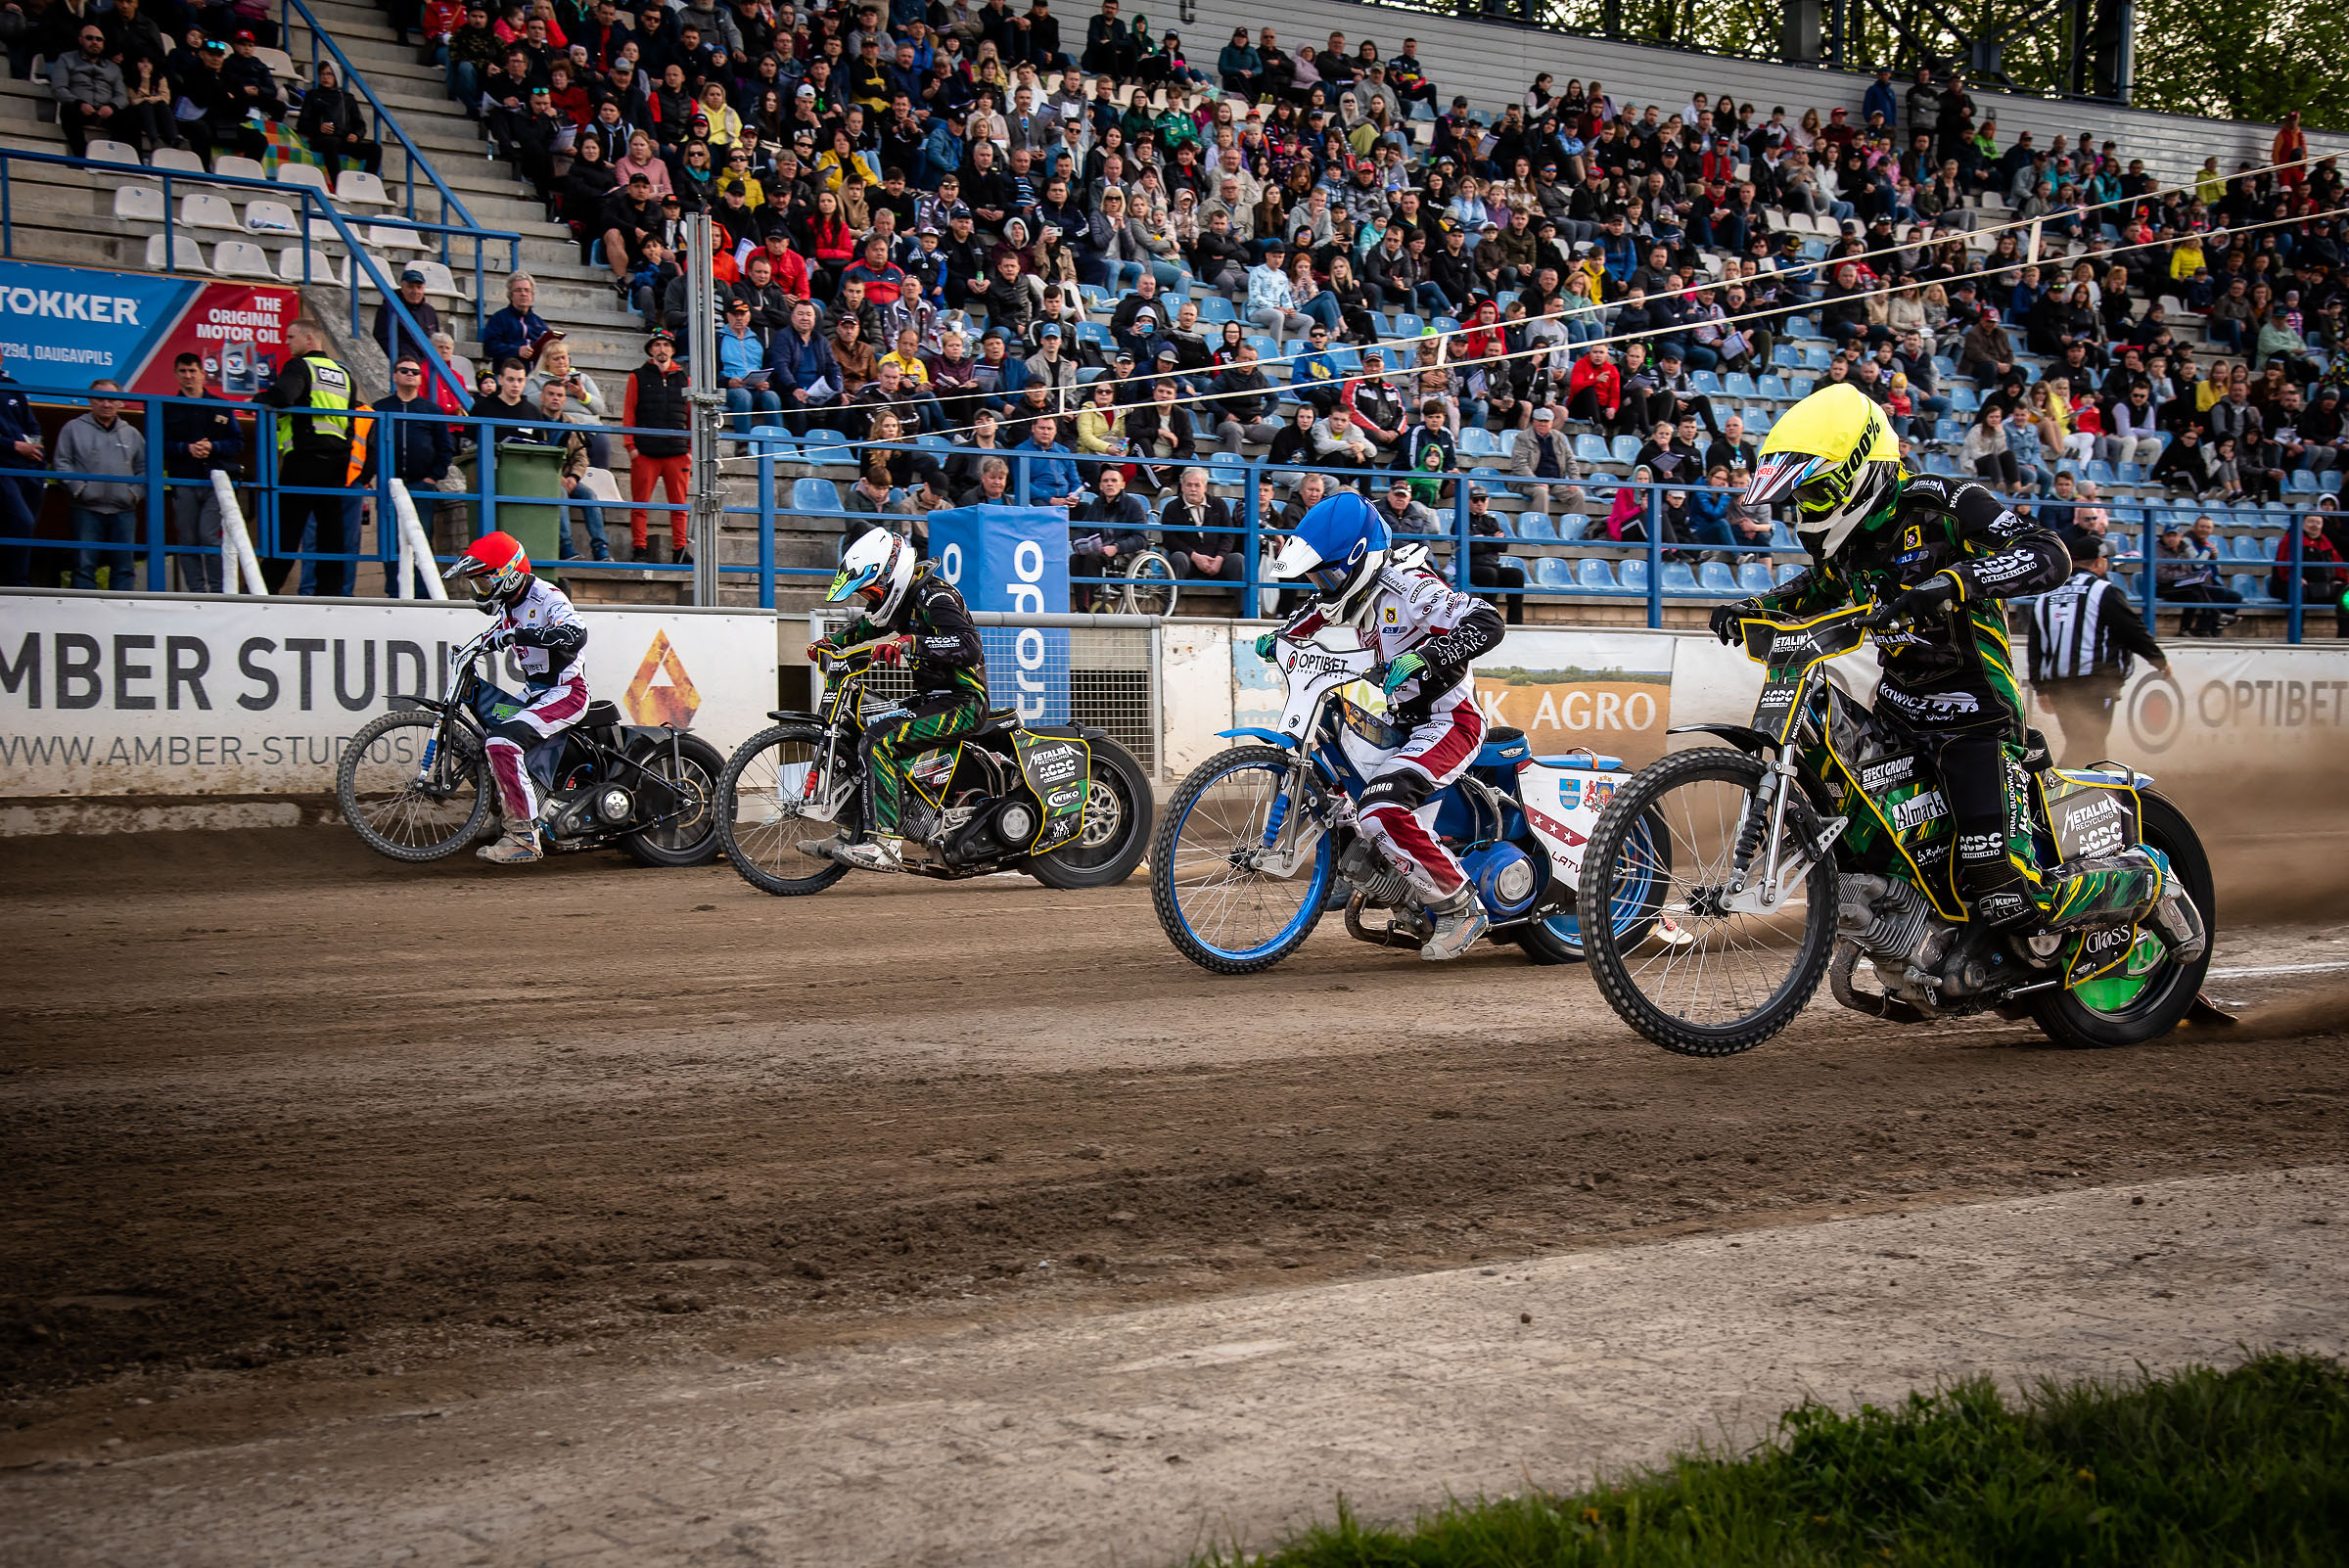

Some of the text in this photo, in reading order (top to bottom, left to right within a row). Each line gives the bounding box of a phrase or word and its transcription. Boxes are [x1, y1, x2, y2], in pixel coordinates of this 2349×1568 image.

[492, 258, 500, 270] 7
[254, 297, 282, 312] THE
[208, 308, 282, 328] ORIGINAL
[197, 323, 282, 344] MOTOR OIL
[34, 346, 114, 366] DAUGAVPILS
[1838, 416, 1881, 482] 100%
[1972, 548, 2035, 577] ACDC
[508, 571, 522, 587] Ara
[1989, 565, 2029, 582] RECYCLING
[1447, 636, 1482, 665] BEAR
[0, 631, 212, 711] MBER
[1299, 653, 1348, 673] OPTIBET
[1761, 689, 1796, 703] ACDC
[2198, 679, 2349, 727] OPTIBET
[1479, 690, 1657, 731] K AGRO
[1027, 742, 1084, 772] METALIKA
[1884, 756, 1914, 776] GROUP
[1039, 759, 1077, 780] ACDC
[1053, 790, 1080, 803] WIKO
[1360, 782, 1394, 801] PROMO
[2006, 756, 2018, 838] FIRMA BUDOWLANA
[1898, 798, 1948, 829] Almark
[2061, 792, 2134, 844] METALIKA
[2075, 811, 2114, 832] RECYCLING
[2079, 821, 2123, 856] ACDC
